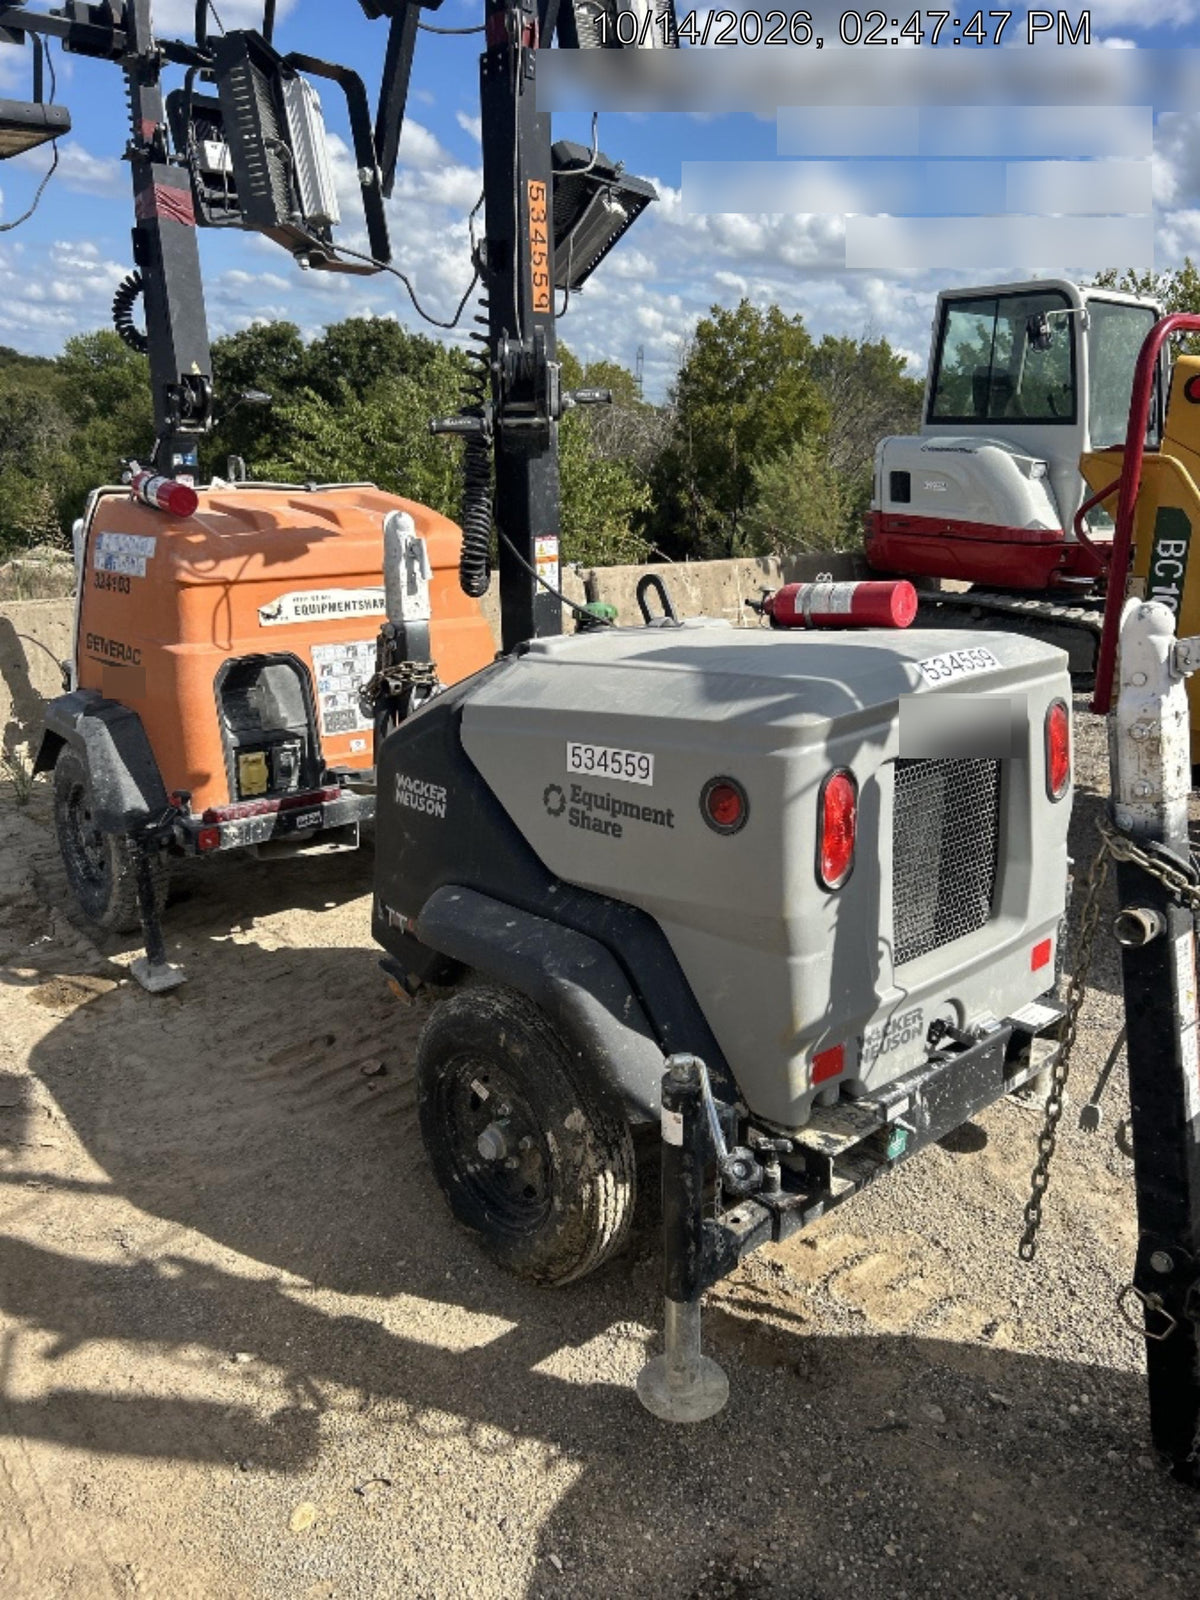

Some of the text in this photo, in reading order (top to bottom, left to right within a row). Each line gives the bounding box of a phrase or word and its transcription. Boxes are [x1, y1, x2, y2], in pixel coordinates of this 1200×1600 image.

[528, 184, 549, 309] 534559
[86, 632, 141, 665] GENERAC
[920, 649, 996, 680] 534559
[571, 746, 650, 779] 534559
[395, 772, 447, 802] WACKER
[395, 788, 447, 819] NEUSON
[570, 784, 675, 829] Equipment
[568, 806, 623, 838] Share
